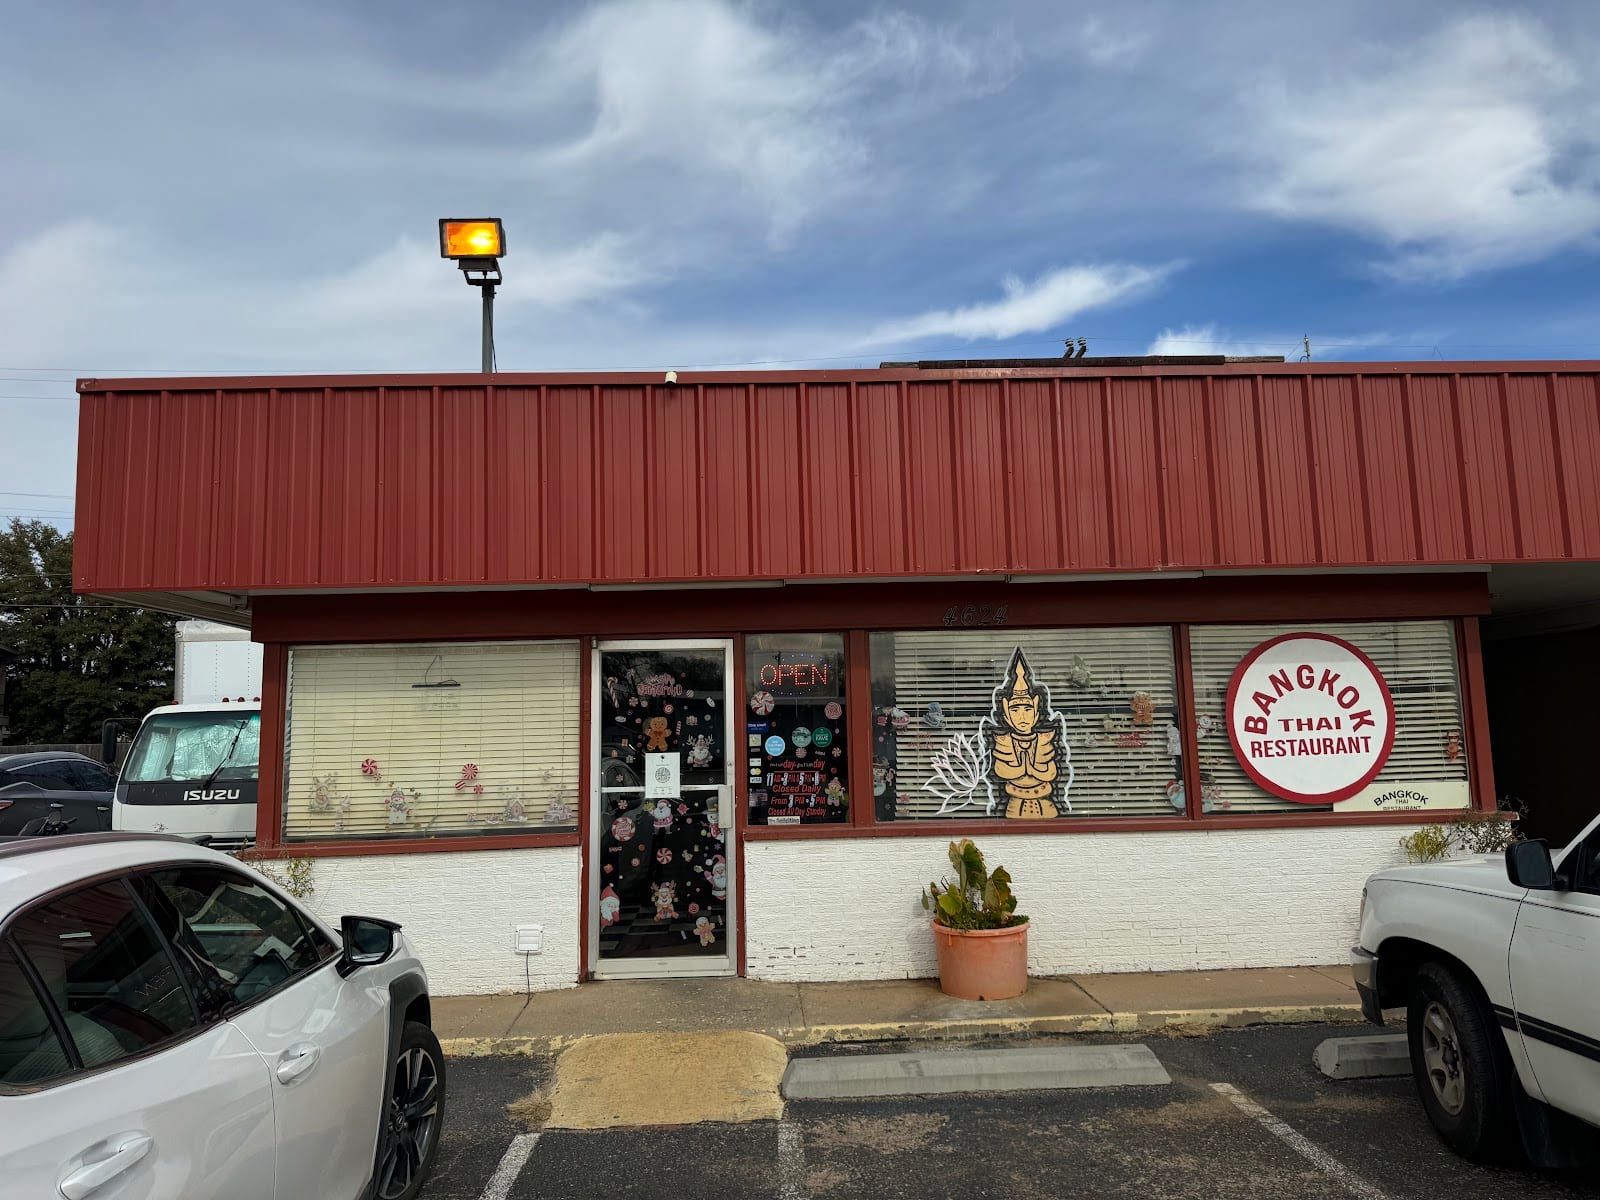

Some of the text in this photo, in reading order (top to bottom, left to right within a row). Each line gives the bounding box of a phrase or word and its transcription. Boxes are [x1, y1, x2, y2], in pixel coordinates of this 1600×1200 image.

[943, 606, 1008, 626] 4624
[760, 664, 827, 685] OPEN
[1244, 664, 1375, 735] BANGKOK
[1278, 716, 1342, 732] THAI
[1250, 736, 1372, 758] RESTAURANT
[183, 789, 240, 801] ISUZU
[772, 784, 800, 793] Closed
[801, 784, 821, 794] Daily
[770, 796, 788, 805] From
[794, 796, 804, 804] PM
[816, 796, 826, 804] PM
[1373, 790, 1429, 806] BANGKOK
[767, 807, 786, 815] Closed
[795, 807, 805, 817] Day
[805, 807, 827, 816] Sunday
